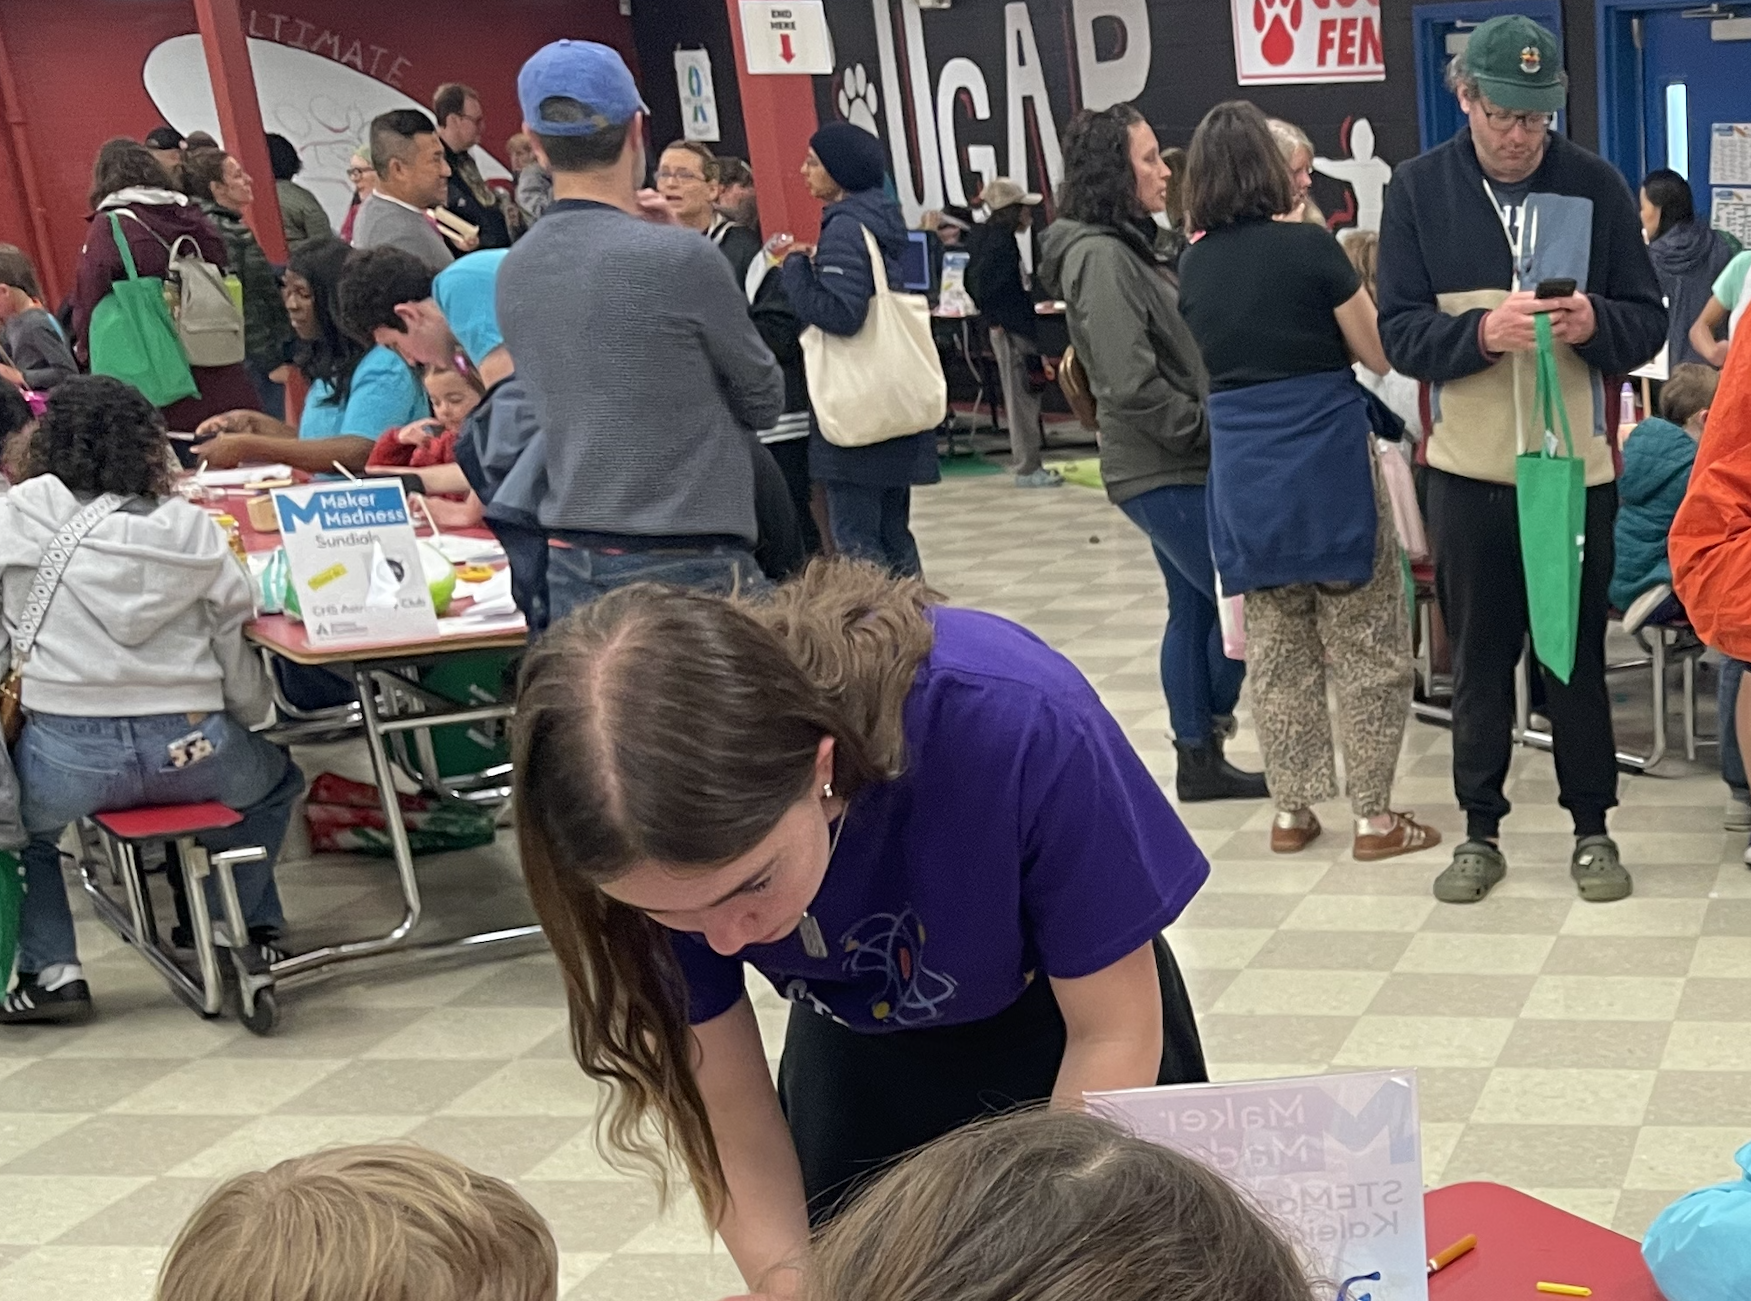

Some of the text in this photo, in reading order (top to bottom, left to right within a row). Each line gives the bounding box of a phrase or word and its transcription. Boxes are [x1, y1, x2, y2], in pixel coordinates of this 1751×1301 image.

[770, 9, 793, 19] END
[770, 21, 797, 31] HERE
[320, 492, 375, 511] Maker
[325, 508, 407, 528] Madness
